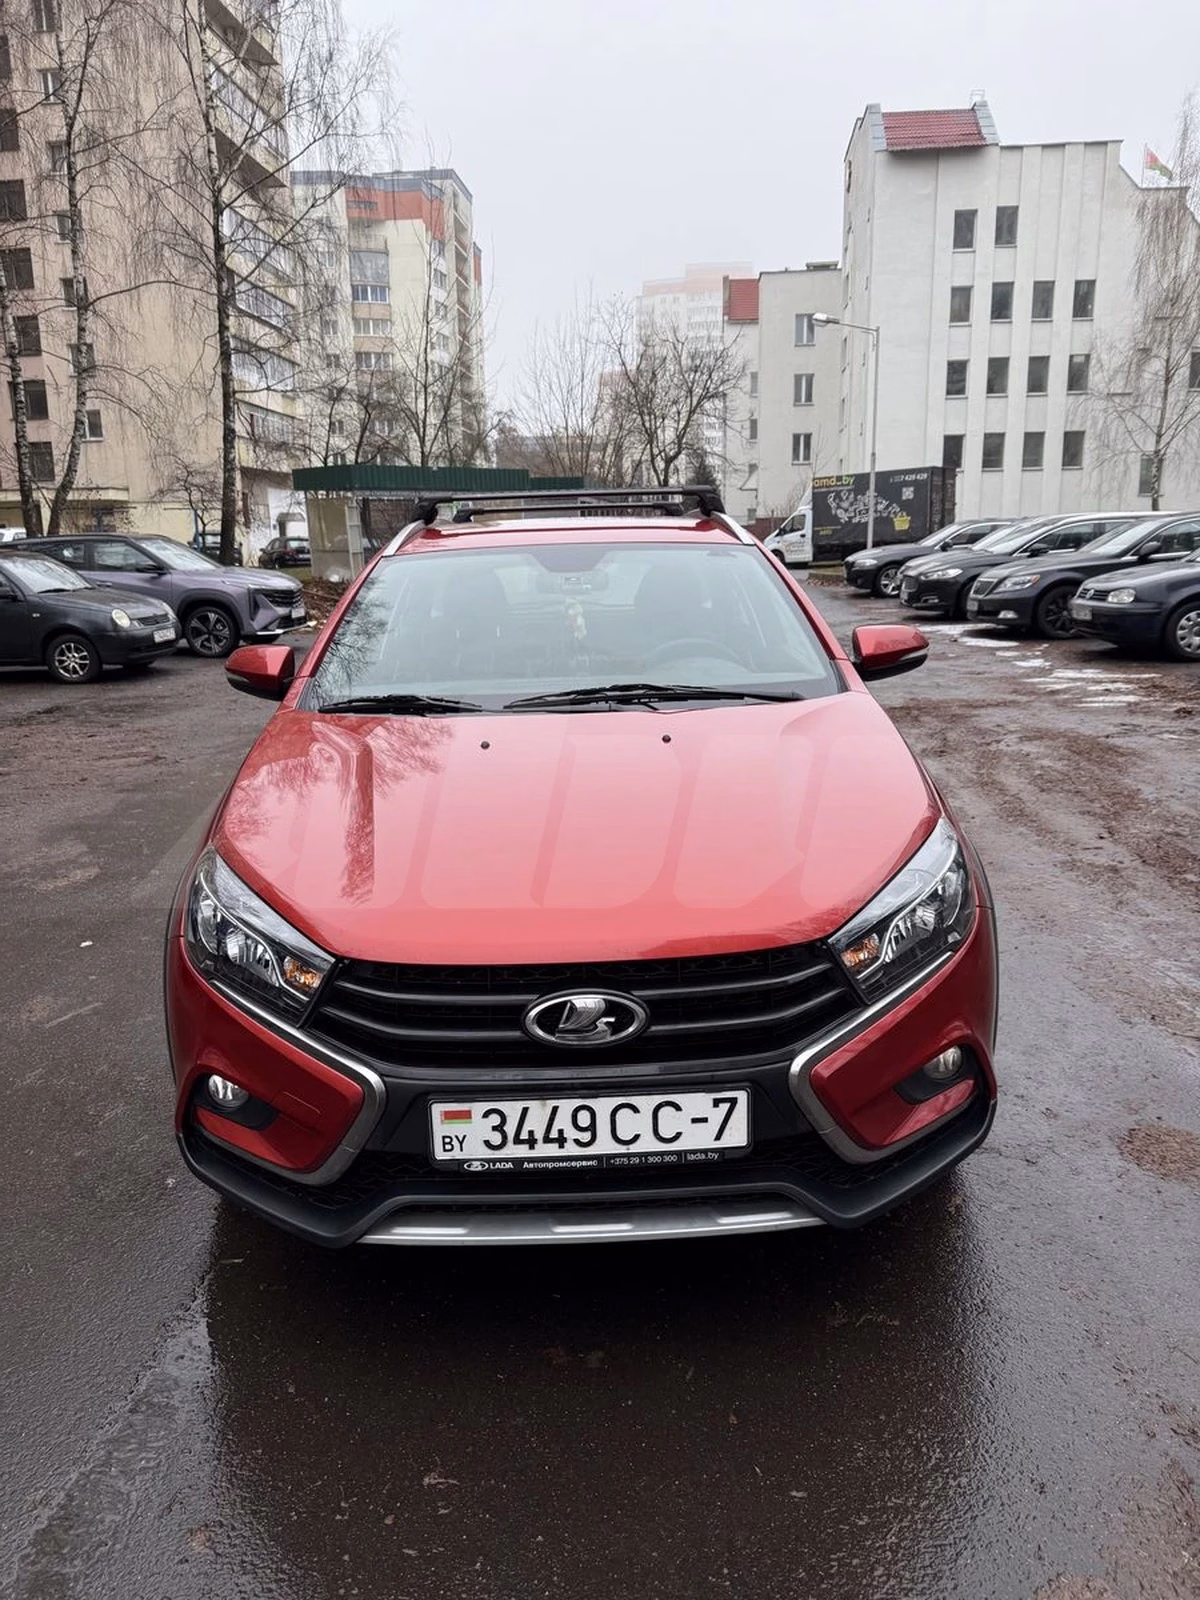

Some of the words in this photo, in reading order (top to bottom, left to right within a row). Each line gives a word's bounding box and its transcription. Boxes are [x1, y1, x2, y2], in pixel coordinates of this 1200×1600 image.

[441, 1134, 467, 1152] BY
[523, 1159, 598, 1169] Автопромсервис
[610, 1157, 629, 1165] +375
[629, 1156, 640, 1164] 29
[647, 1155, 662, 1163] 300
[663, 1154, 678, 1162] 300
[686, 1151, 720, 1161] lada.by
